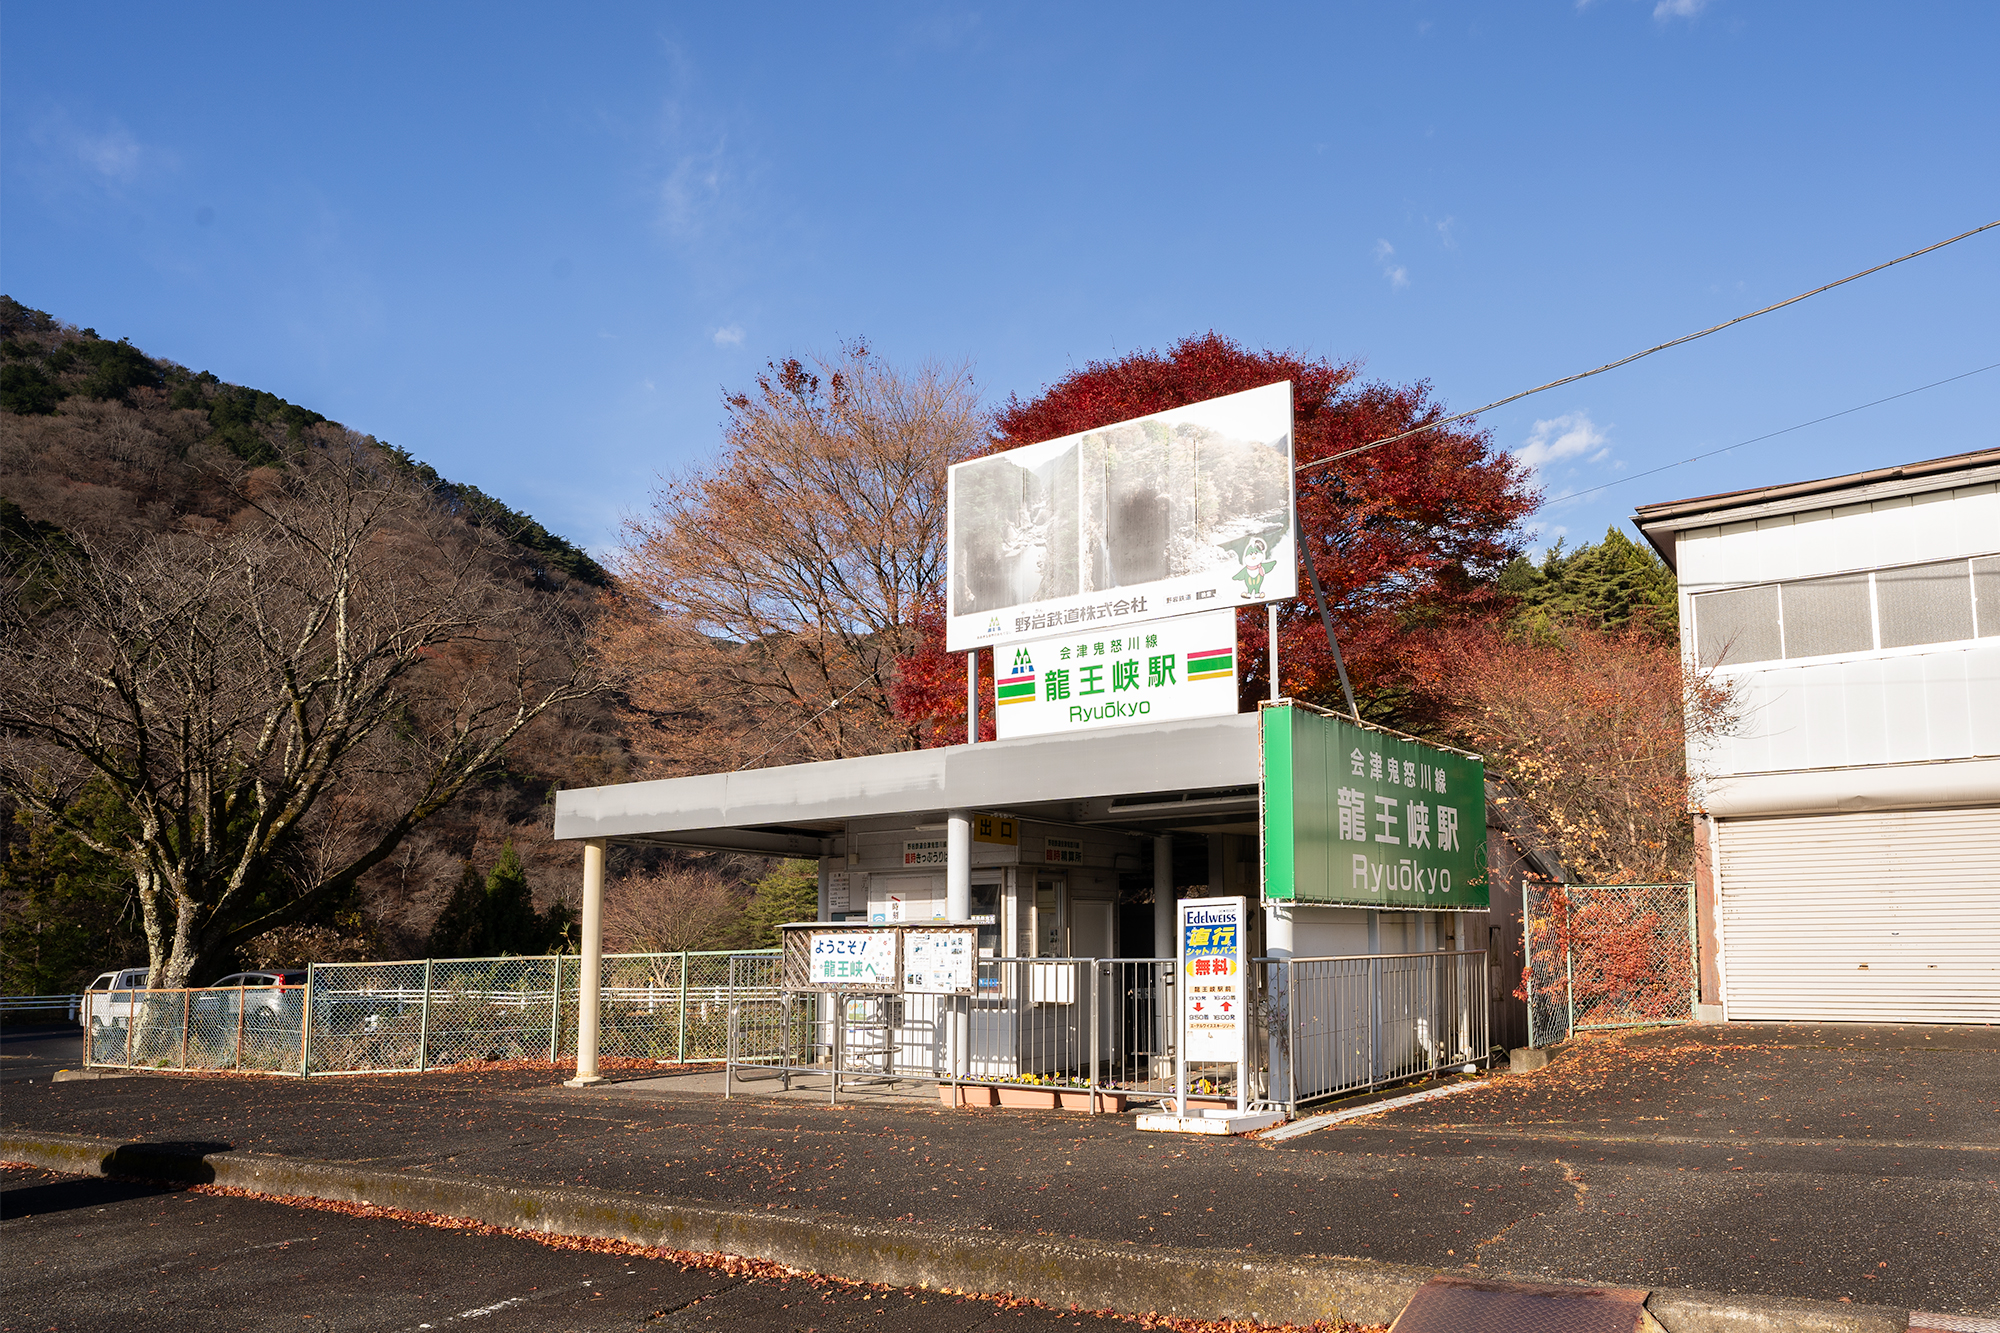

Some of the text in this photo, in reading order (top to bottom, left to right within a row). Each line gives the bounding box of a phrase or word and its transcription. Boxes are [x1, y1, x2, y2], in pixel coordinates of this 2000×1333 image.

[1015, 596, 1148, 632] 野岩鉄道株式会社
[1060, 634, 1158, 660] 会津鬼怒川線
[1045, 654, 1177, 702] 龍王峡駅
[1069, 700, 1151, 723] Ryuōkyo
[1350, 747, 1447, 795] 会津鬼怒川線
[980, 818, 1012, 838] 出口
[1337, 786, 1460, 853] 龍王峡駅
[1352, 854, 1451, 894] Ryuōkyo
[815, 939, 867, 955] ようこそ!
[1189, 927, 1235, 946] 直行
[1186, 946, 1237, 956] シャトルバス
[824, 960, 877, 977] 龍王峡へ
[1195, 958, 1228, 975] 無料
